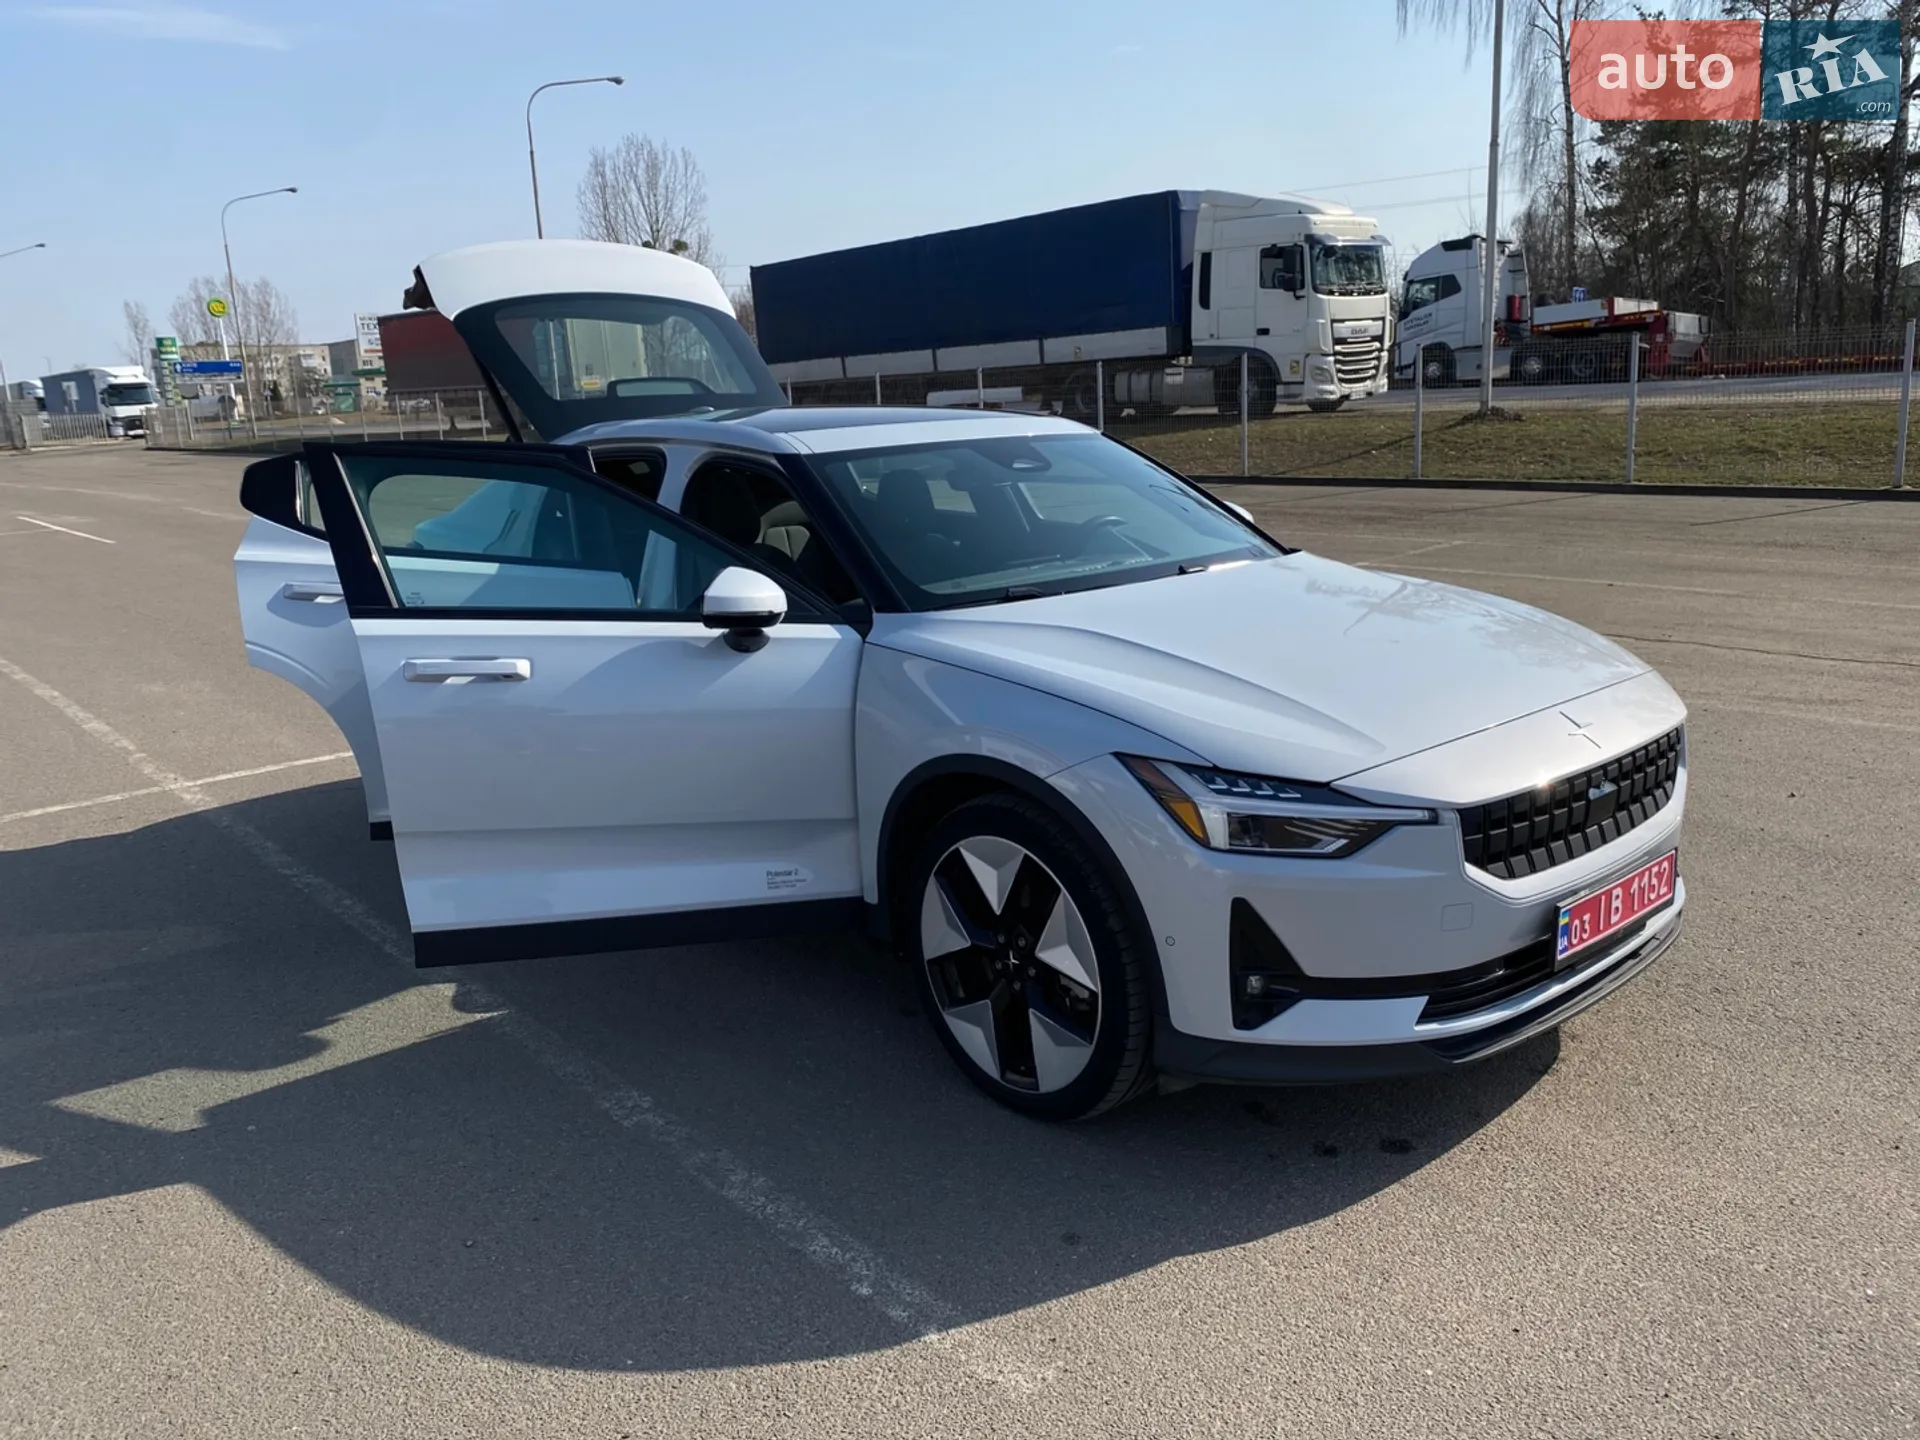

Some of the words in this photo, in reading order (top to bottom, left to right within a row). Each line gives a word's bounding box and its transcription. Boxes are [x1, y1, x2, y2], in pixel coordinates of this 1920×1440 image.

[1571, 913, 1591, 945] 03
[1599, 887, 1623, 931] IB
[1630, 861, 1670, 911] 1152
[1558, 937, 1568, 950] UA
